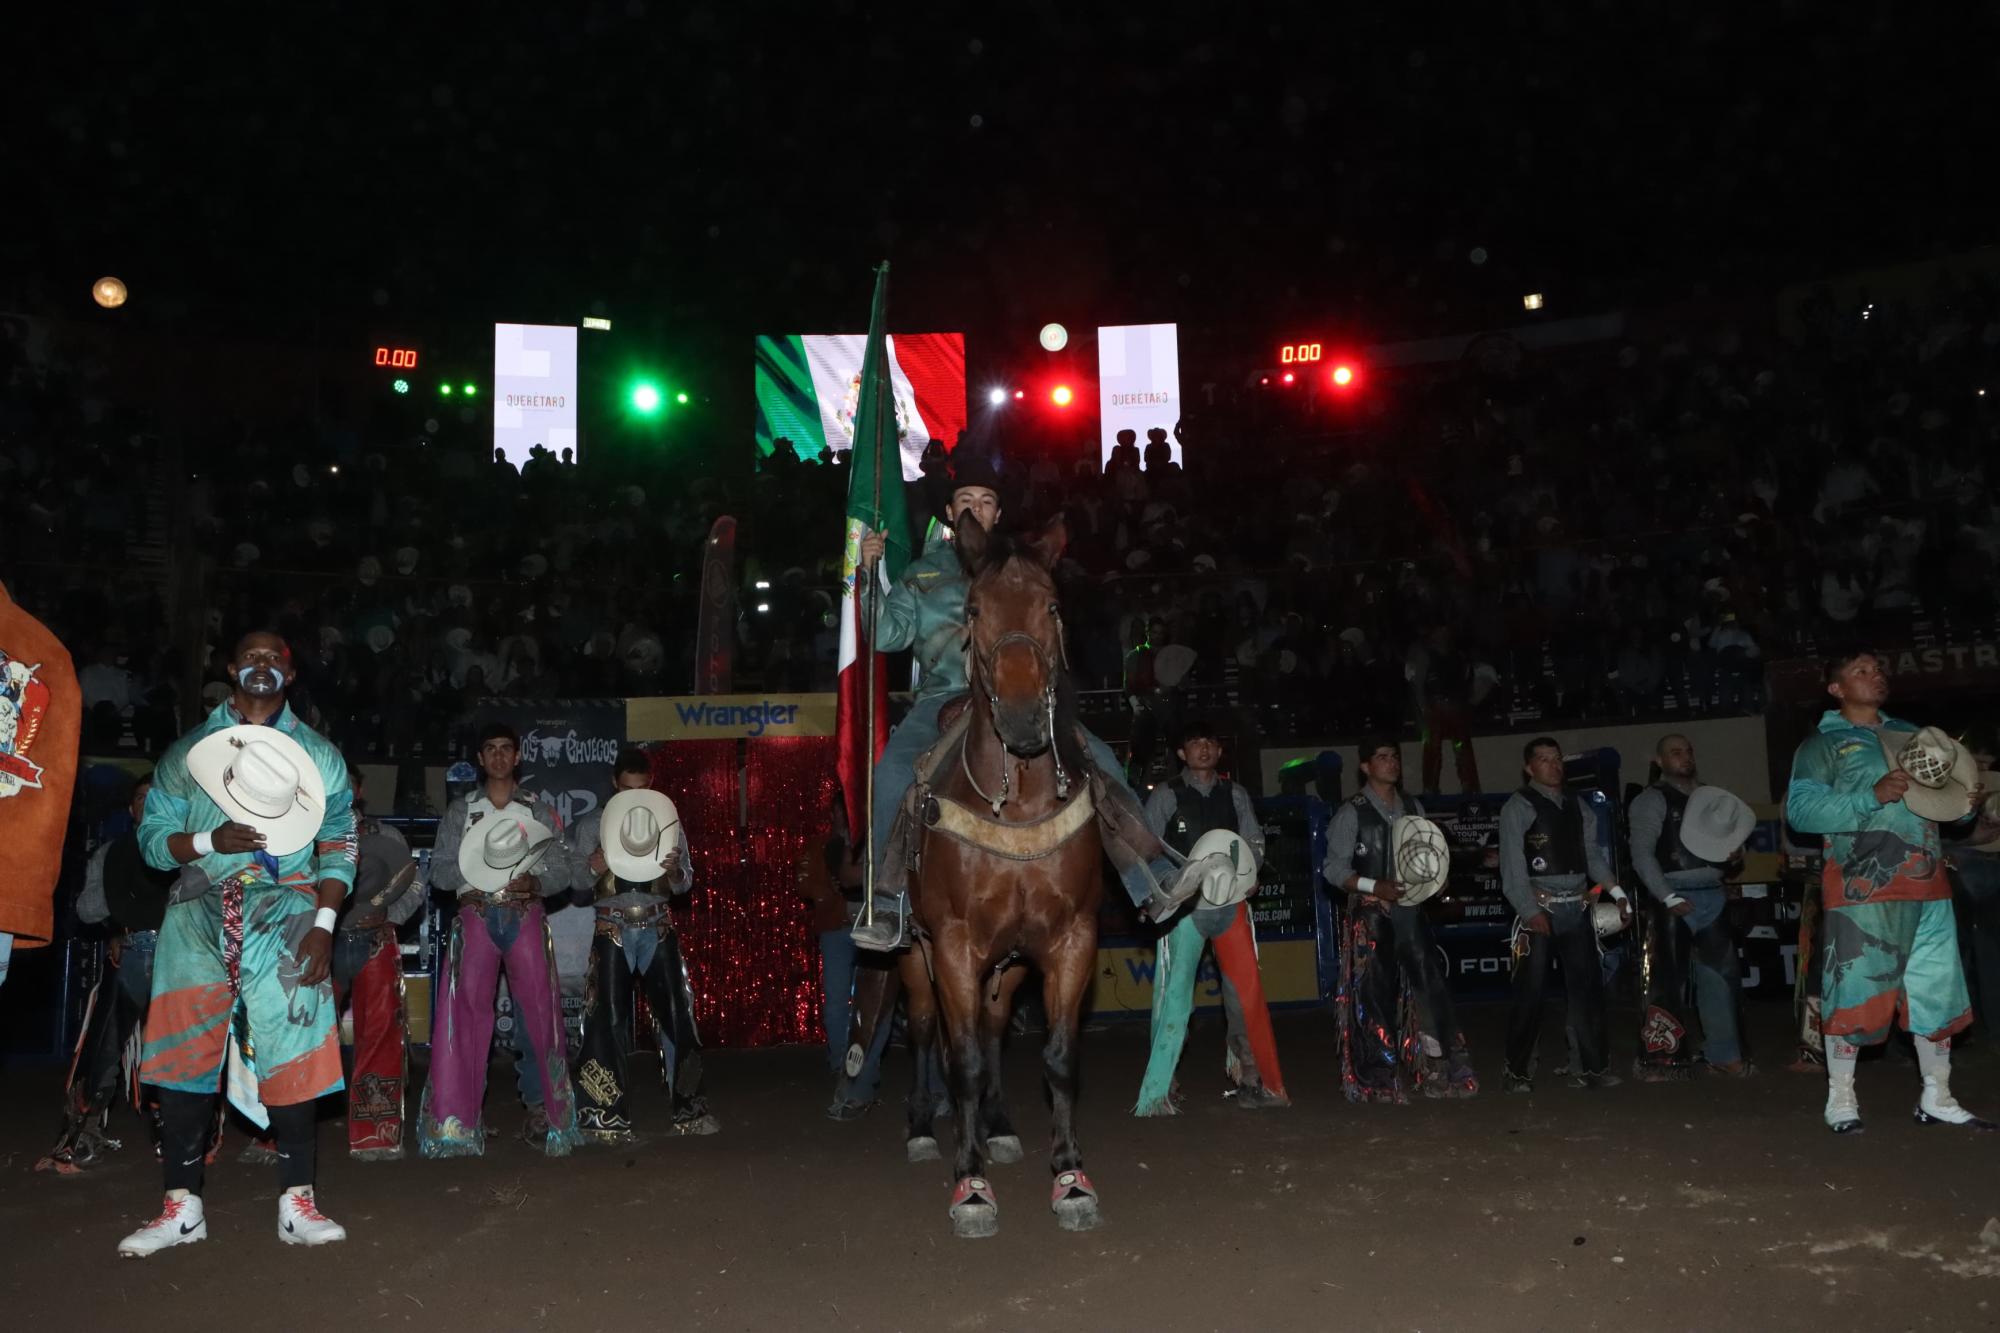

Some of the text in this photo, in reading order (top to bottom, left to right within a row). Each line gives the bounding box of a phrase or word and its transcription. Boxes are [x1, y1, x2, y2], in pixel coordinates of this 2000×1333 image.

[375, 347, 417, 368] 0.00
[1281, 343, 1321, 364] 0.00
[675, 701, 799, 737] Wrangler
[1258, 883, 1286, 897] 2024
